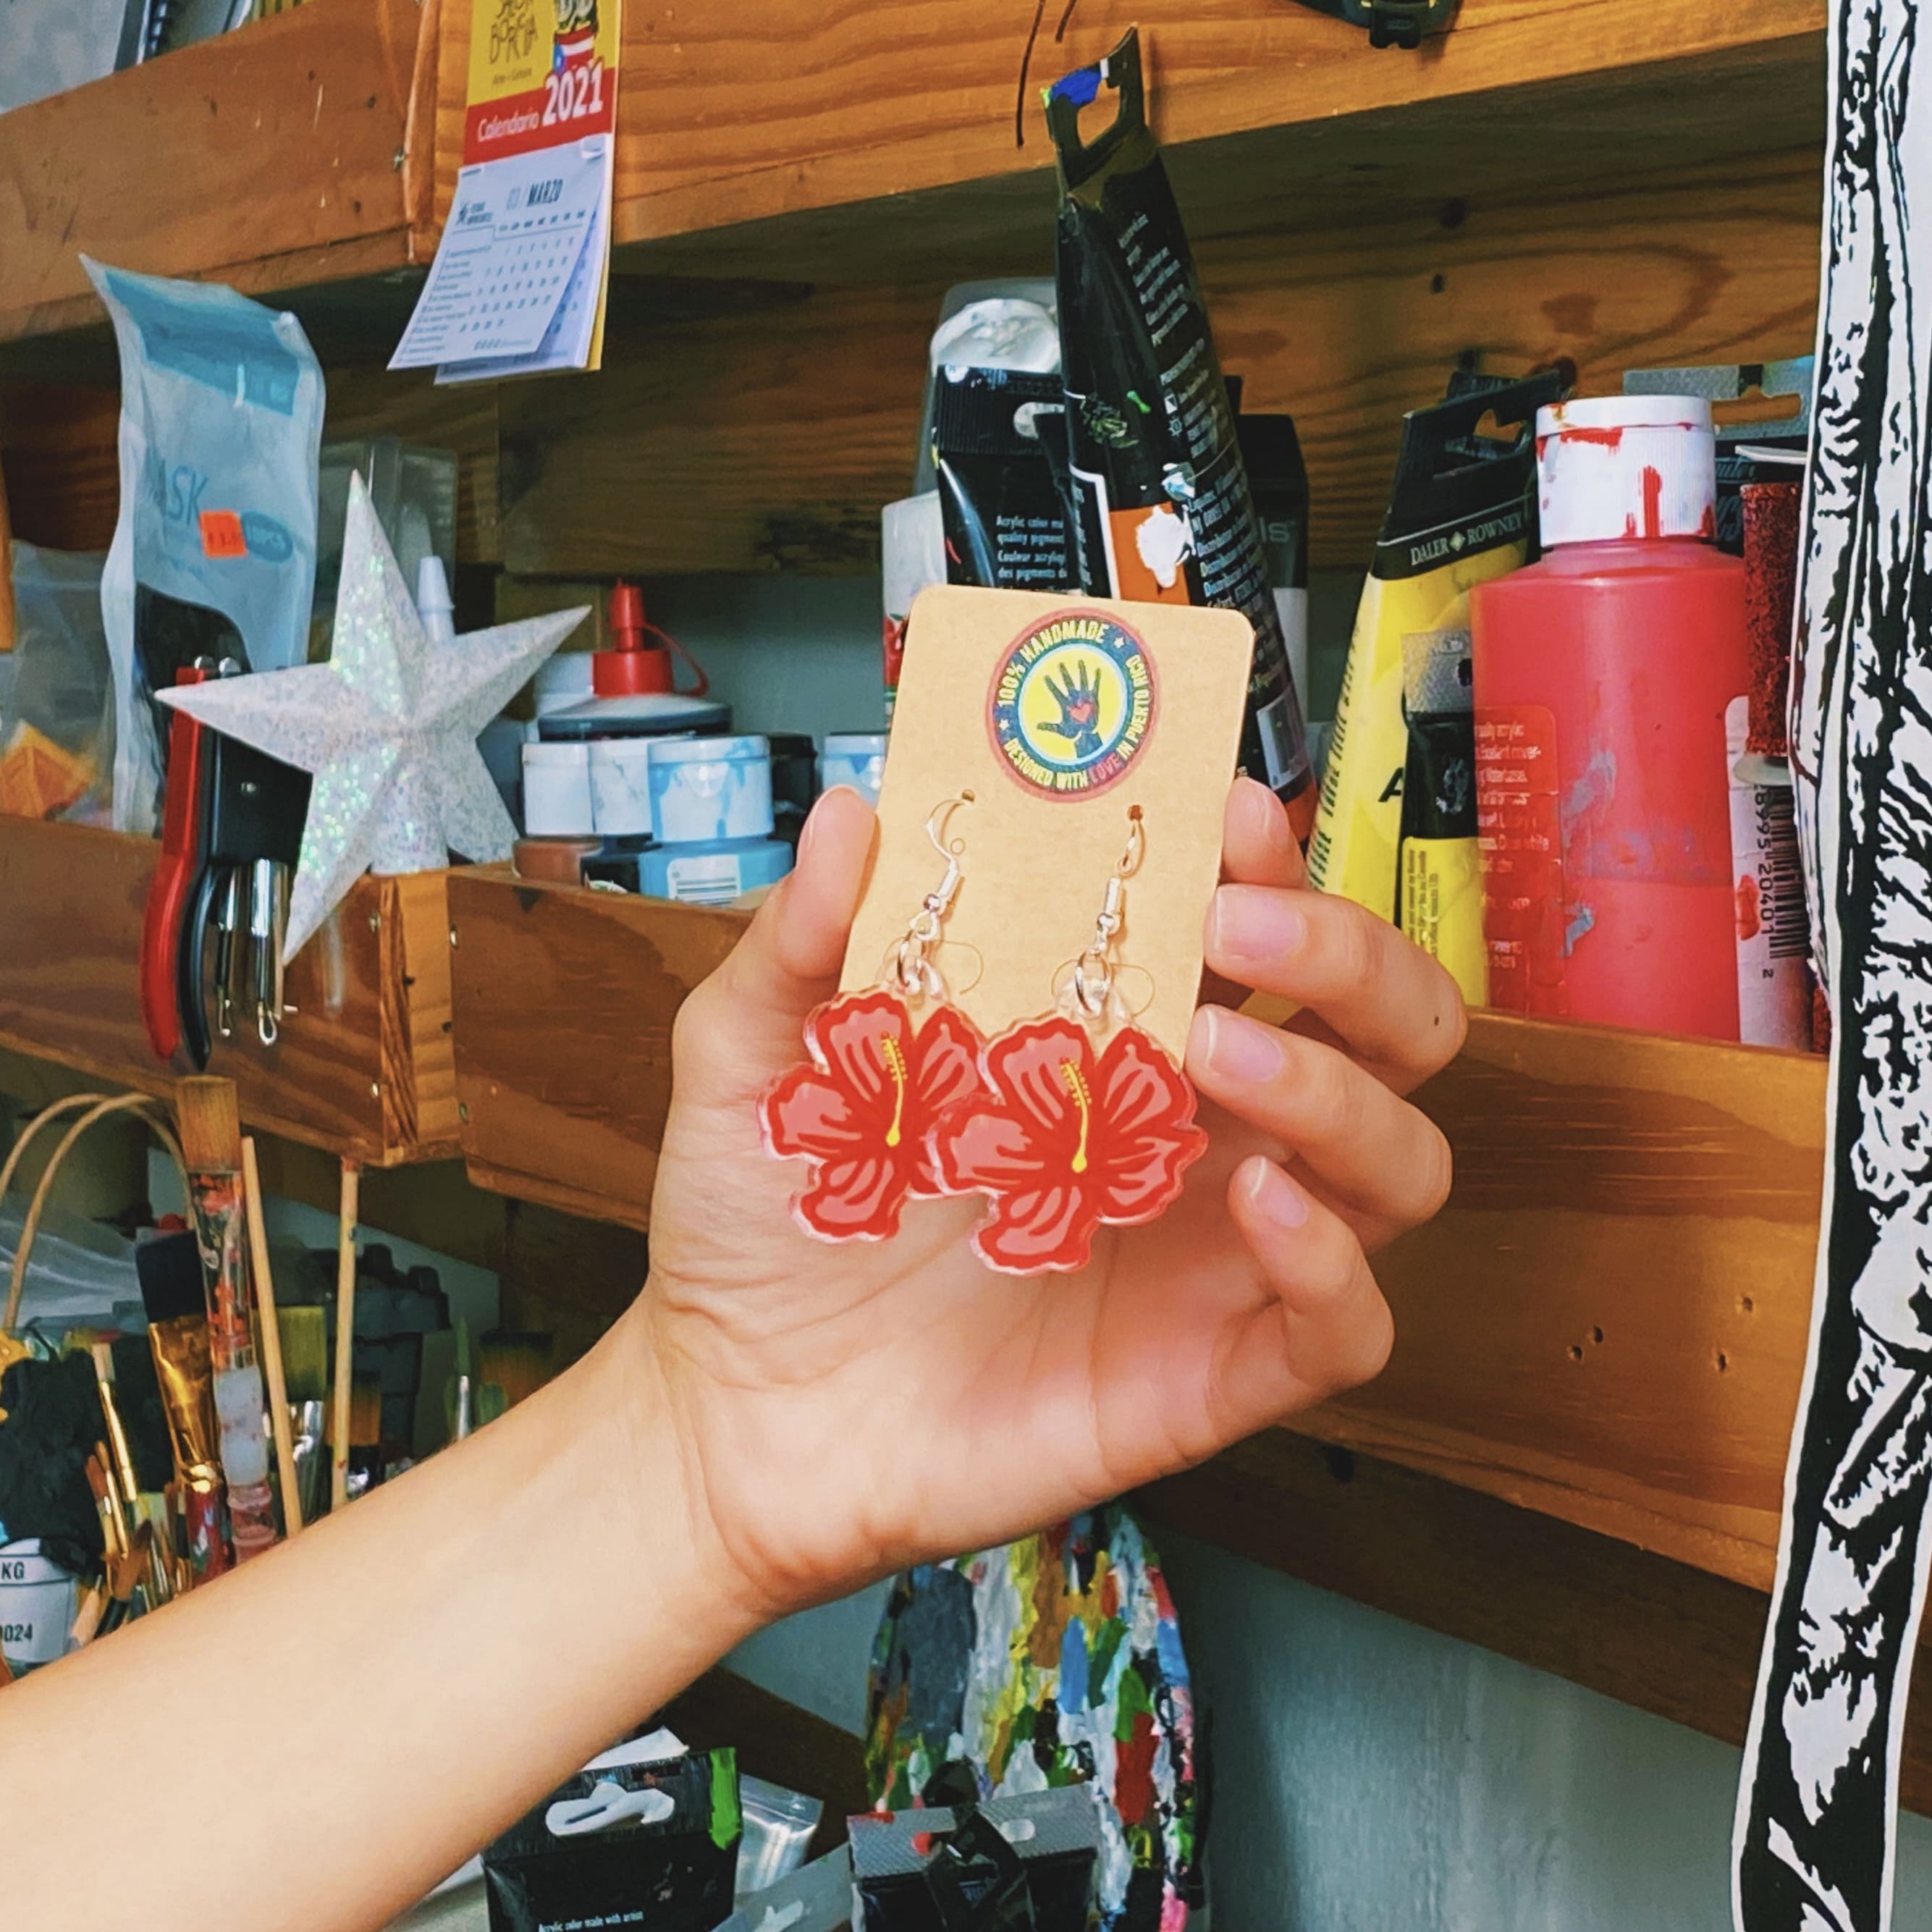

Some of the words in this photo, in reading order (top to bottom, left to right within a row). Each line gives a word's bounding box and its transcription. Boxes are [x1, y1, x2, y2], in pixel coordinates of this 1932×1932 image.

[478, 107, 540, 143] Calendario
[543, 58, 603, 127] 2021
[526, 178, 563, 208] MARZO
[1410, 537, 1450, 567] DALER
[1467, 511, 1523, 546] ROWNEY
[997, 660, 1026, 707] 100%
[1019, 619, 1110, 664] HANDMADE
[1126, 654, 1149, 687] RICO
[1127, 688, 1152, 744] PUERTO
[1003, 738, 1054, 785] DESIGNED
[1087, 752, 1123, 785] LOVE
[1115, 739, 1135, 760] IN
[1056, 769, 1089, 791] WITH
[1758, 863, 1773, 935] 20401
